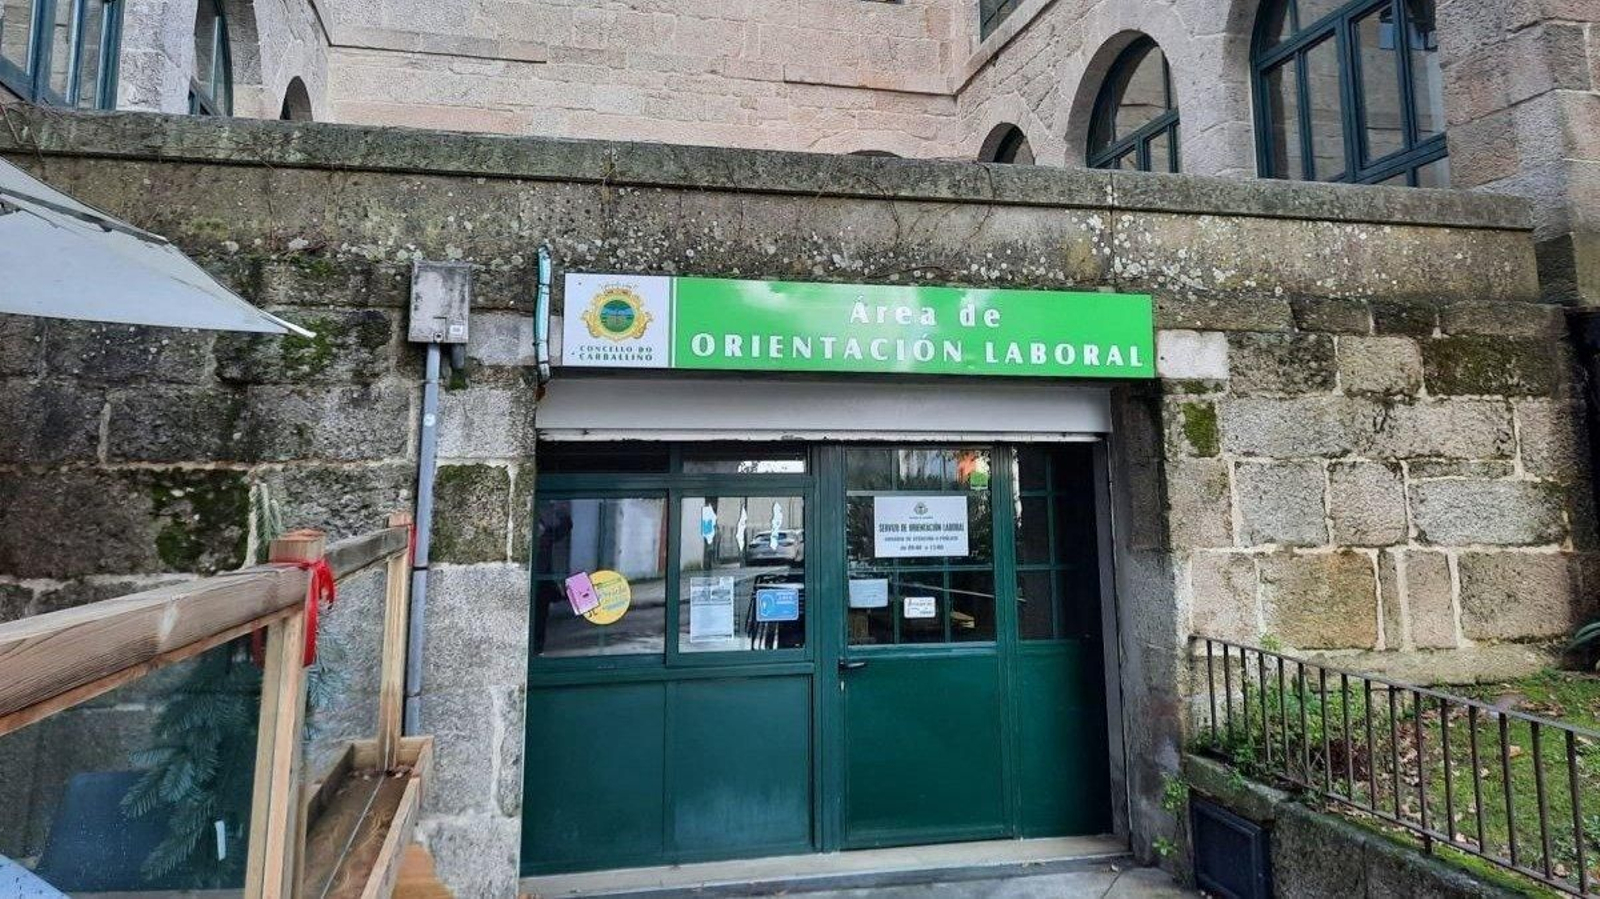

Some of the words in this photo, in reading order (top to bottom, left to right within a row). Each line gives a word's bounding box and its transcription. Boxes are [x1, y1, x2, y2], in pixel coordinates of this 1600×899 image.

[849, 295, 937, 326] Área
[958, 304, 1001, 328] de
[690, 332, 963, 363] ORIENTACIÓN
[985, 341, 1144, 367] LABORAL
[901, 523, 908, 532] DE
[943, 523, 964, 531] LABORAL
